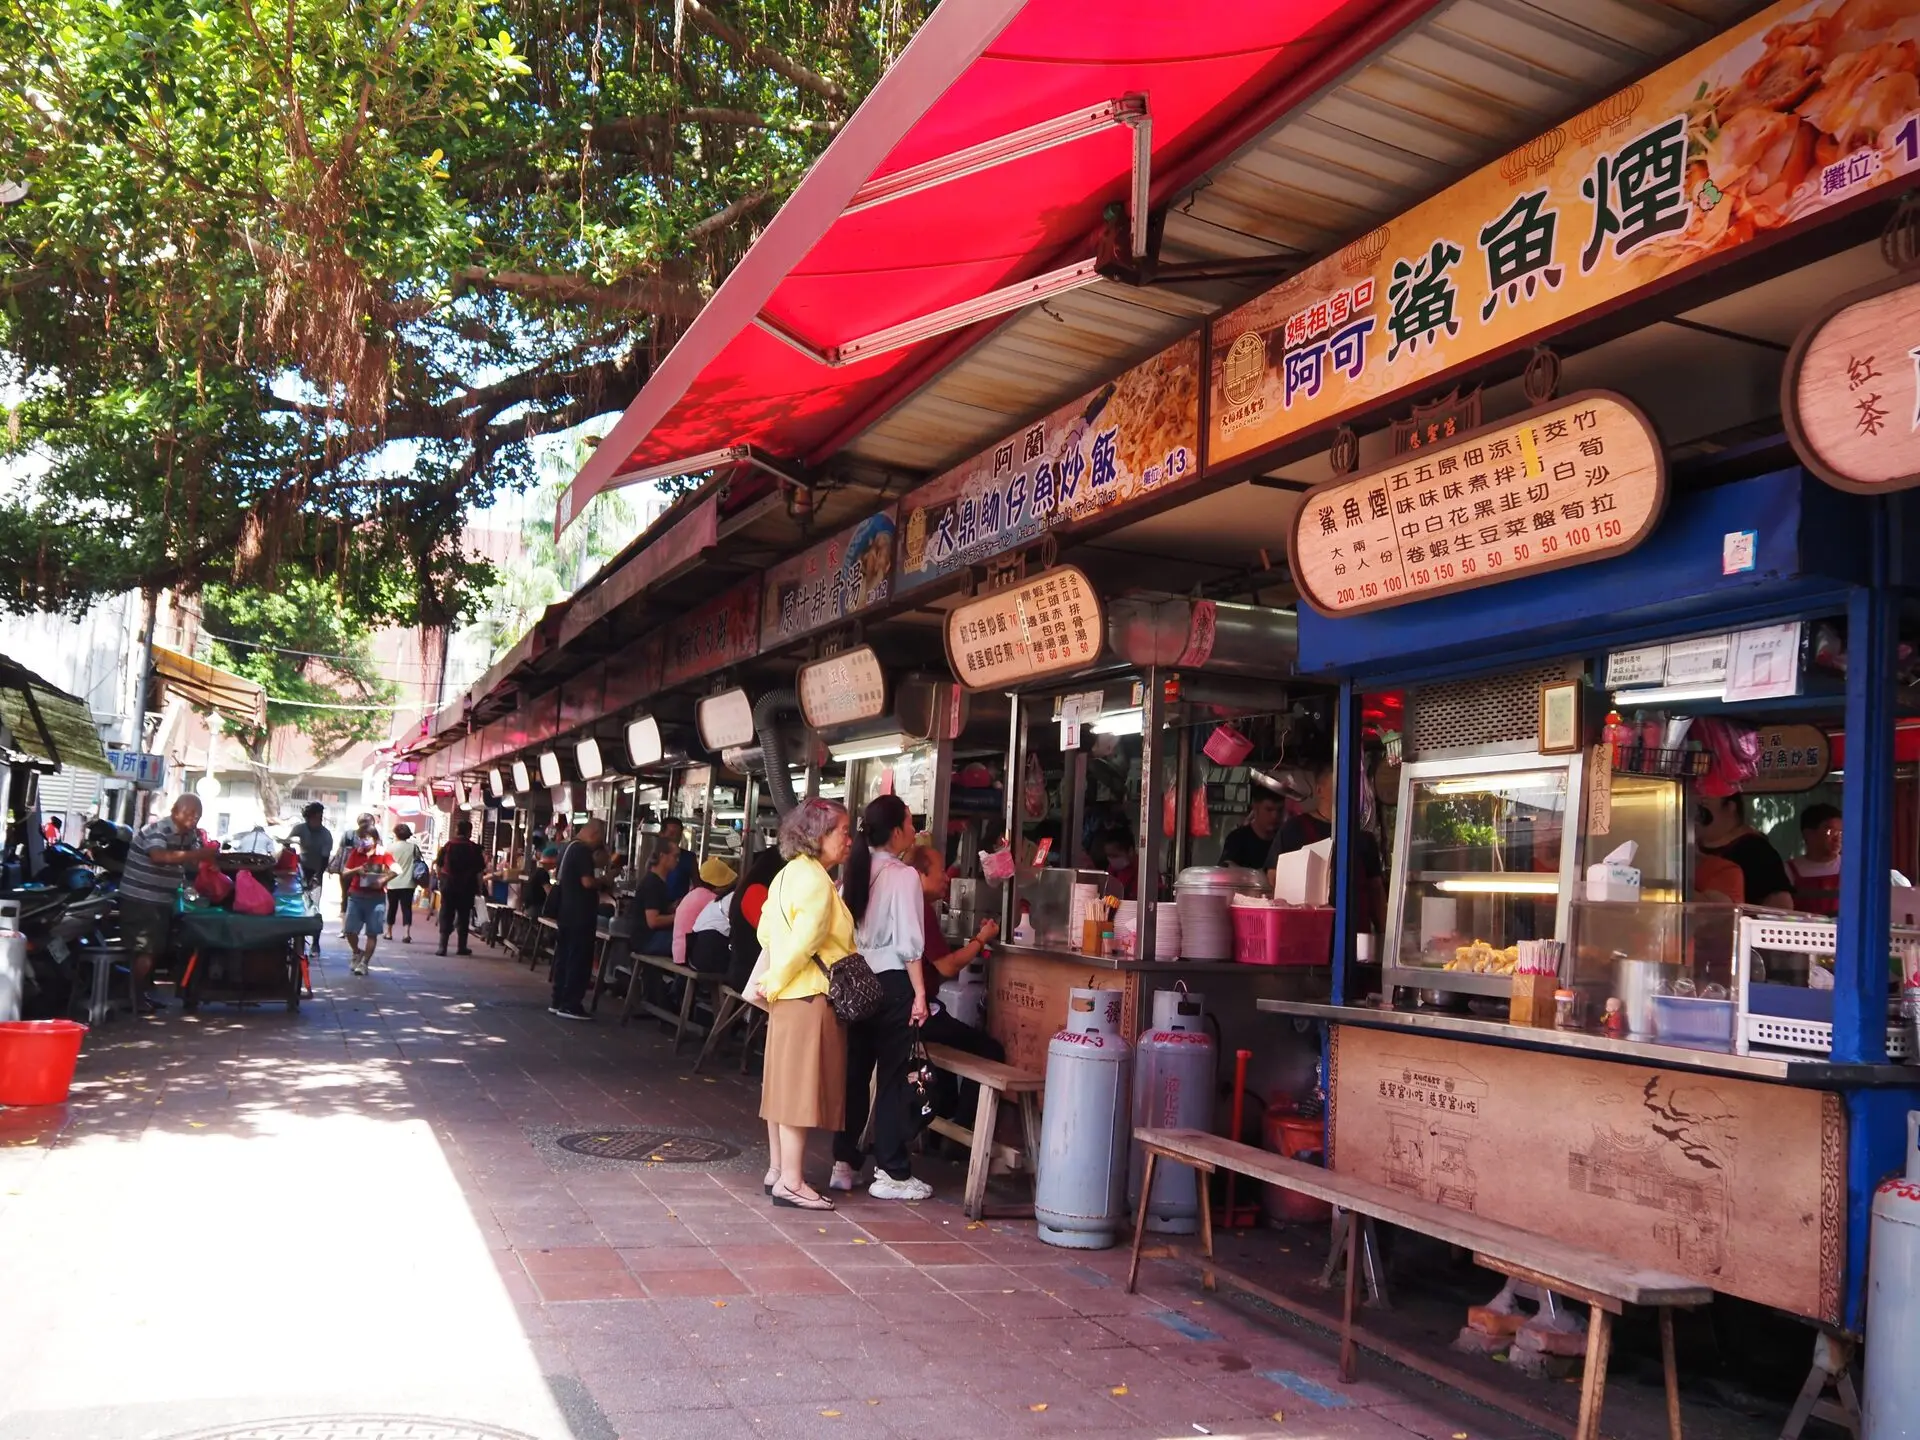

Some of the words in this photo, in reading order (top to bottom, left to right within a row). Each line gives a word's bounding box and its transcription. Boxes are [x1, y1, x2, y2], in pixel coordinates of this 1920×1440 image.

[1389, 118, 1689, 362] 鯊魚煙
[1286, 280, 1373, 343] 媽祖宮口
[1285, 318, 1375, 407] 阿可
[1847, 354, 1890, 437] 紅茶
[994, 423, 1045, 476] 阿蘭
[1166, 449, 1186, 476] 13
[1097, 488, 1117, 506] Rice
[1318, 487, 1390, 537] 鯊魚煙
[1565, 526, 1591, 548] 100
[1595, 519, 1622, 540] 150
[1514, 544, 1530, 562] 50
[1542, 535, 1558, 554] 50
[1462, 557, 1477, 575] 50
[1487, 551, 1503, 568] 50
[1410, 565, 1430, 586] 150
[1434, 562, 1454, 582] 150
[1360, 582, 1378, 598] 150
[1383, 576, 1401, 593] 100
[782, 561, 863, 632] 原汁排骨湯
[1337, 588, 1355, 604] 200
[1379, 1080, 1425, 1102] 慈聖宮小吃
[1428, 1091, 1477, 1114] 慈聖宮小吃
